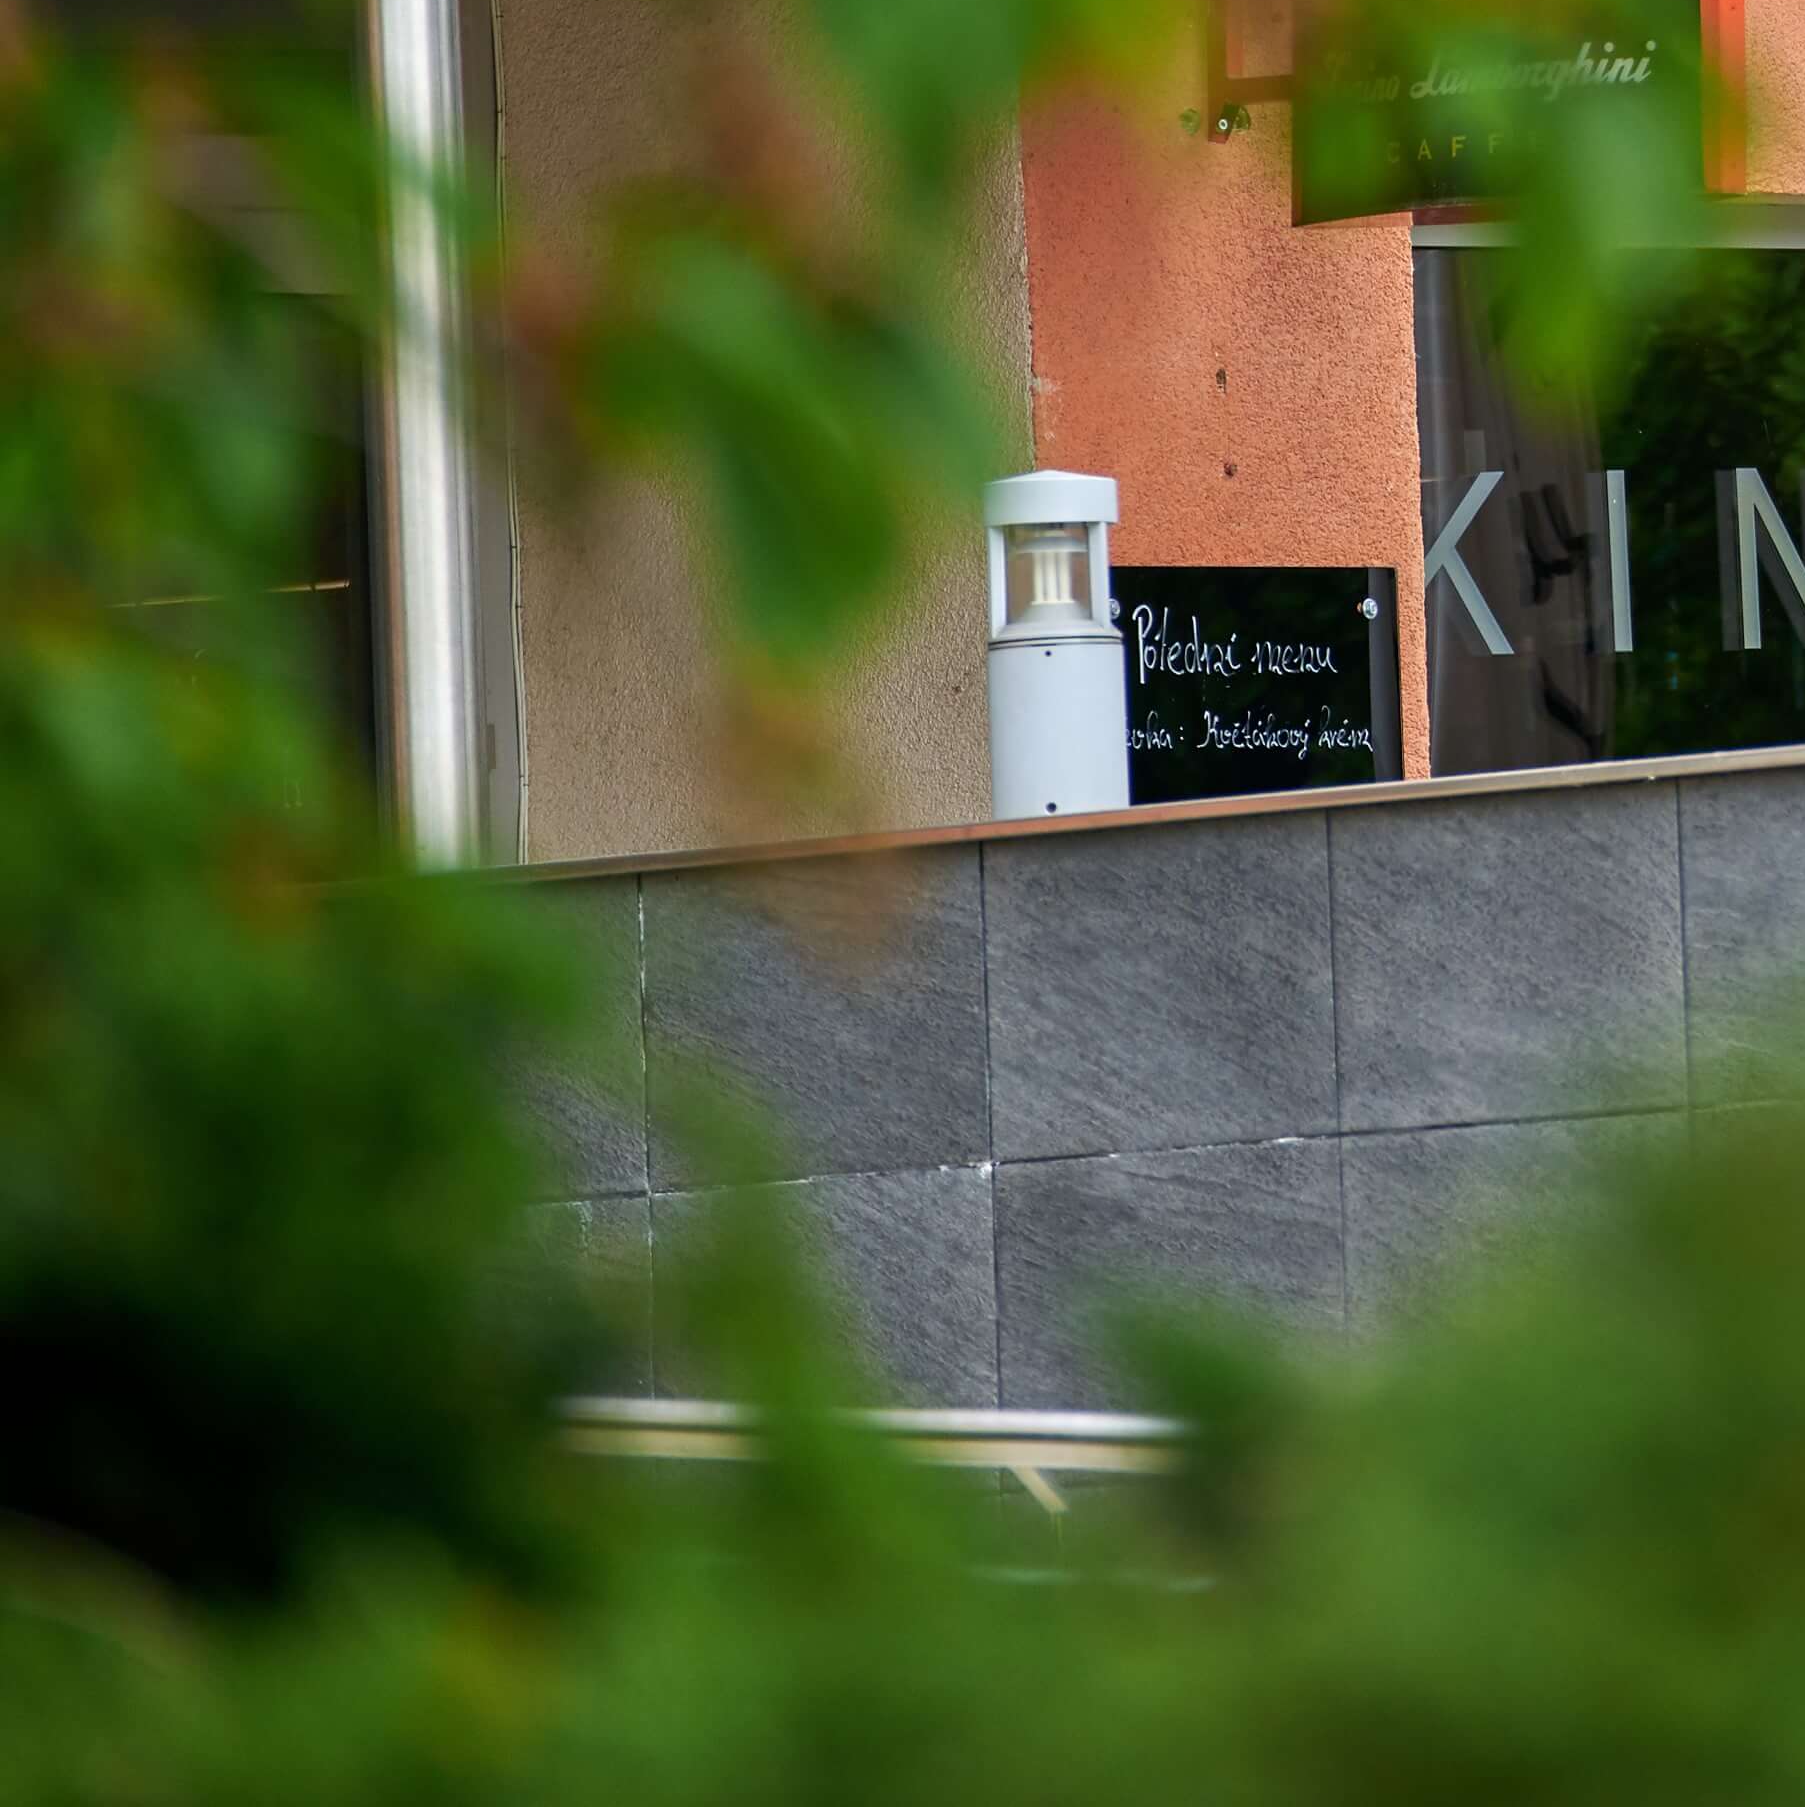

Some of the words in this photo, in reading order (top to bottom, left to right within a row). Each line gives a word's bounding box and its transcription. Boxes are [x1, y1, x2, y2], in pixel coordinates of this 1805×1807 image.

[1409, 39, 1657, 102] Lamorghini
[1386, 128, 1543, 164] CAFF
[1250, 640, 1339, 676] menu
